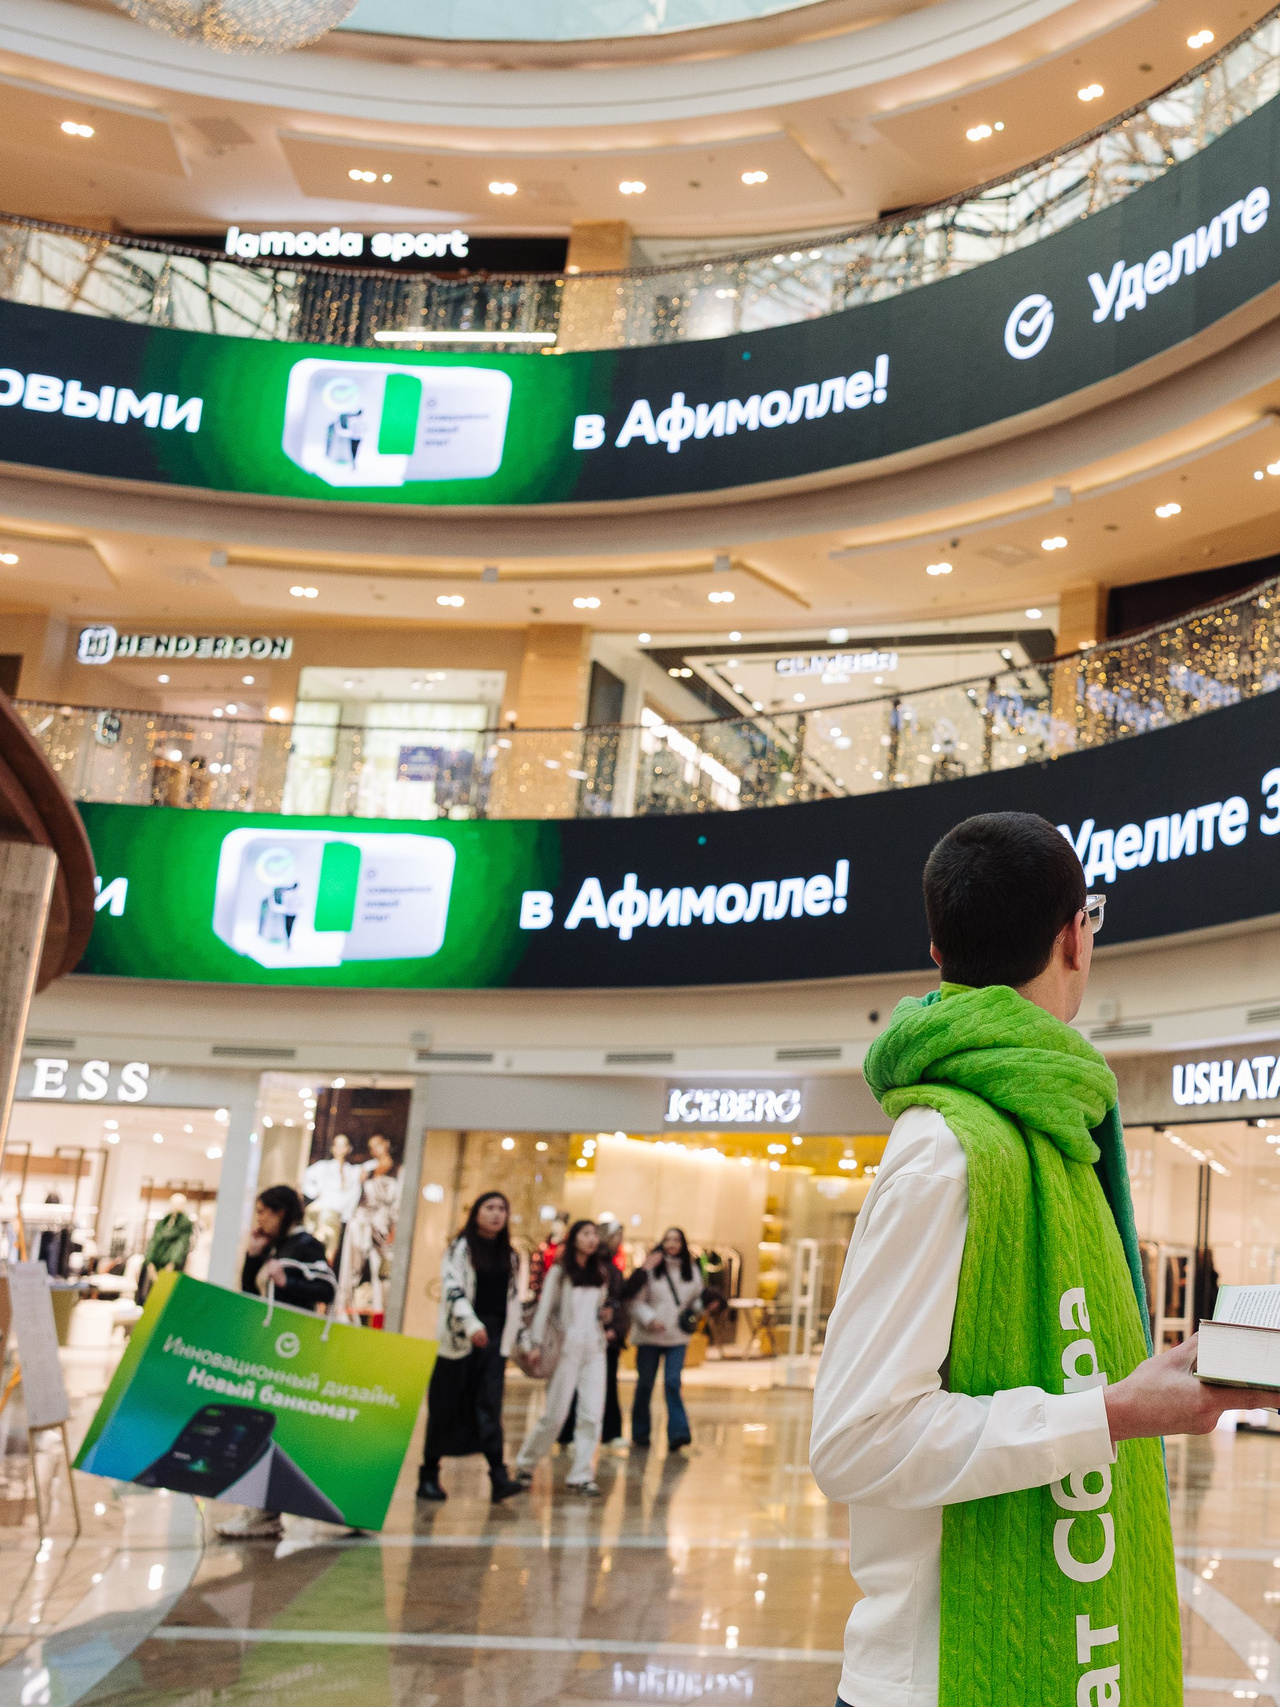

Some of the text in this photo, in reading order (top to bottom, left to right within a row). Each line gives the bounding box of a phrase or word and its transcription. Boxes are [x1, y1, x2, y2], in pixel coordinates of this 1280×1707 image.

[225, 226, 469, 262] lamoda sport
[1087, 186, 1270, 323] Уделите
[572, 414, 605, 450] в
[615, 353, 889, 454] Афимолле!
[116, 634, 294, 661] HENDERSON
[519, 859, 850, 940] в Афимолле!
[29, 1058, 150, 1102] ESS
[664, 1088, 802, 1123] ICEBERG
[163, 1334, 320, 1392] Инновационный
[187, 1365, 360, 1423] Новый банкомат
[1052, 1286, 1117, 1584] Сбра
